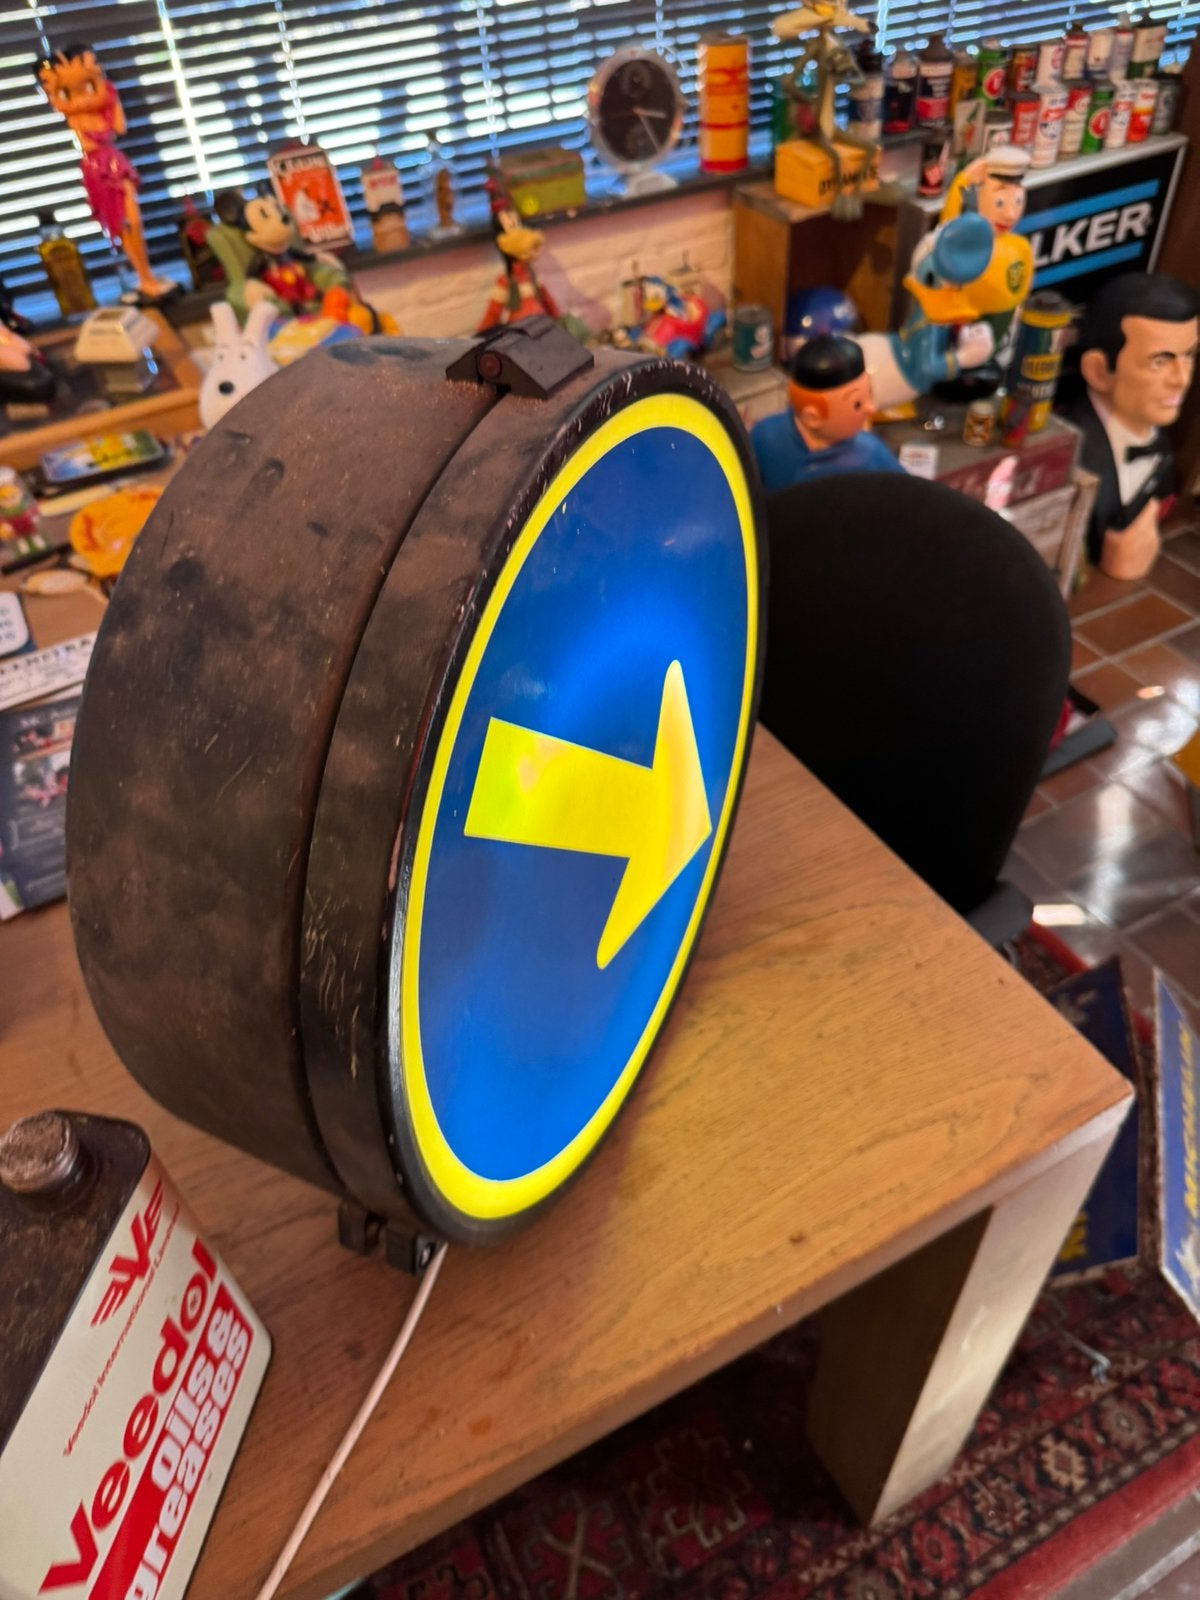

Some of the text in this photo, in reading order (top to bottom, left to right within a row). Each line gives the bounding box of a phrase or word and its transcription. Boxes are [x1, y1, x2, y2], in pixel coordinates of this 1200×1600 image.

[38, 1235, 217, 1594] Veedol
[124, 1322, 249, 1600] greases
[151, 1306, 233, 1492] oils &
